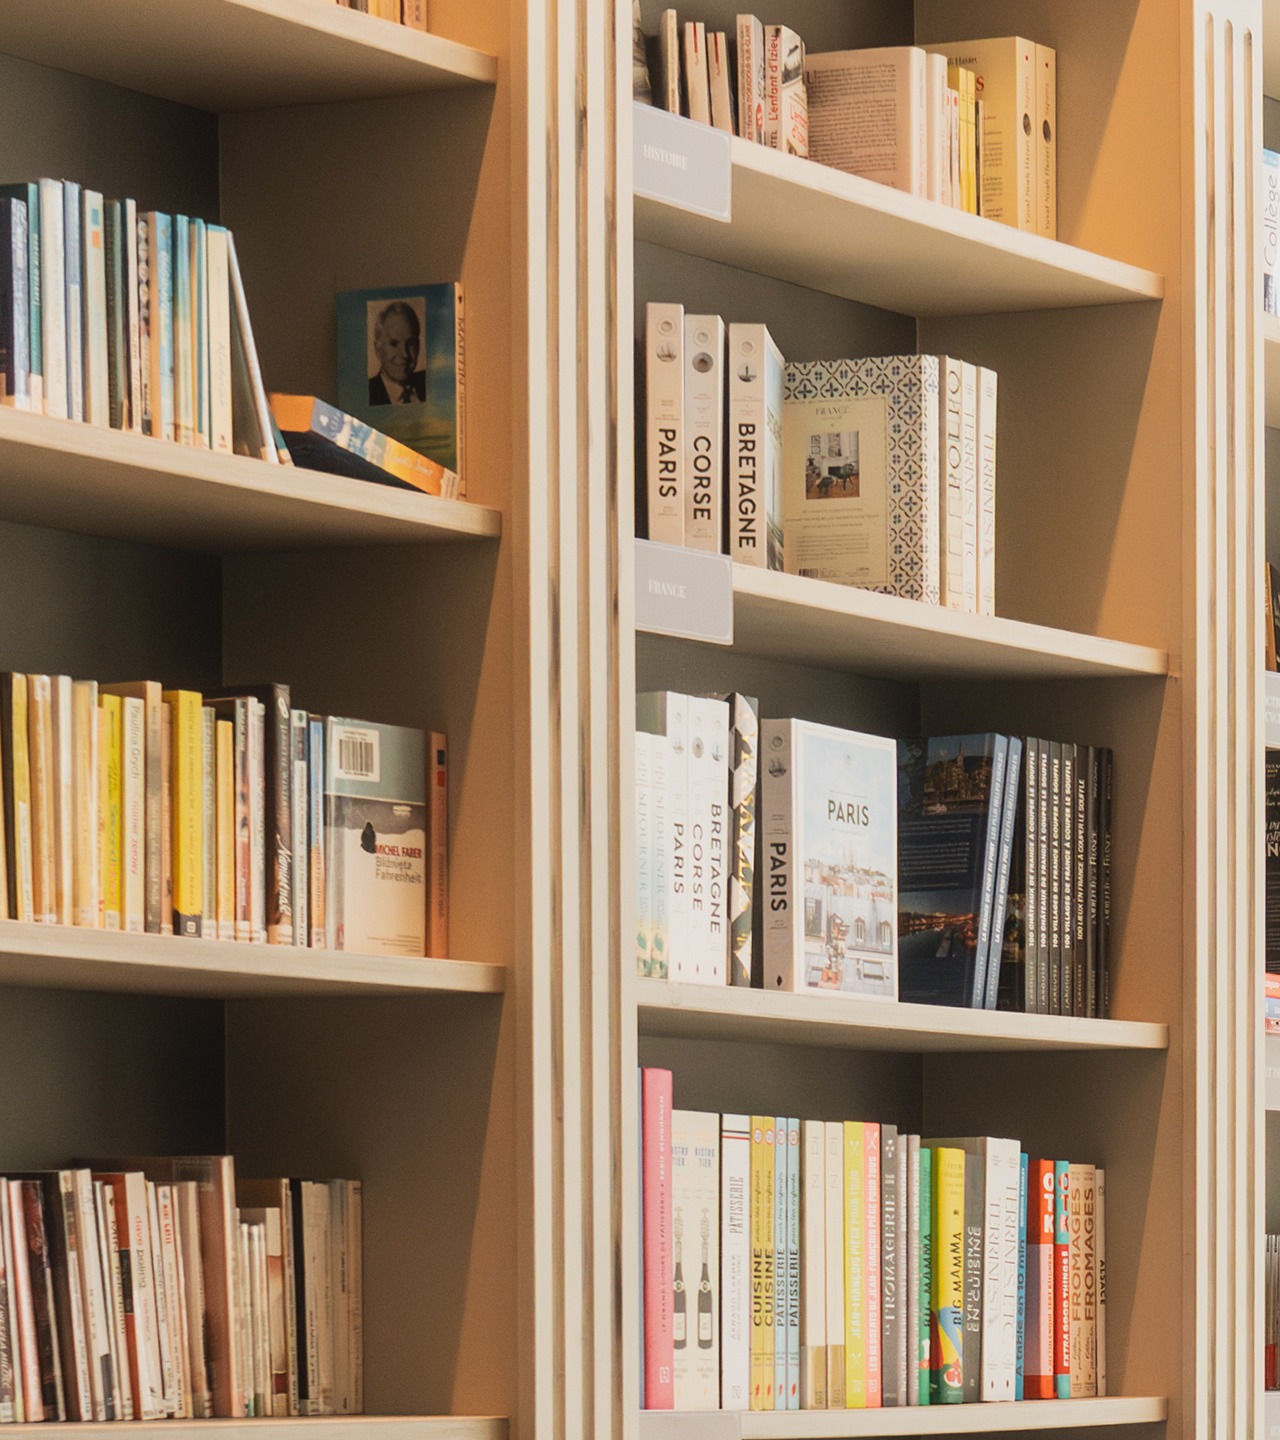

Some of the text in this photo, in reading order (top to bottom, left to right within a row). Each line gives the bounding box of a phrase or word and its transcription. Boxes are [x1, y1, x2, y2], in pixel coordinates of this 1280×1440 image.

[769, 34, 778, 121] L'enfant d'Izieu
[643, 143, 689, 170] HISTOIRE
[1264, 174, 1280, 267] Collège
[658, 427, 677, 498] PARIS
[693, 436, 711, 520] CORSE
[738, 423, 756, 549] BRETAGNE
[648, 579, 686, 598] FRANCE
[129, 747, 140, 780] Grych
[130, 705, 140, 745] Paulina
[375, 844, 423, 859] MICHEL FABER
[827, 799, 870, 827] PARIS
[673, 823, 684, 895] PARIS
[692, 824, 703, 911] CORSE
[710, 803, 722, 934] BRETAGNE
[770, 841, 787, 912] PARIS
[698, 1157, 712, 1167] TIER
[135, 1215, 144, 1246] dave
[851, 1226, 861, 1254] PIÈGE
[868, 1157, 878, 1371] LES DESSERTS JEAN-FRANÇOIS PIÈGE POUR TOUS
[885, 1195, 895, 1320] FROMAGERIE
[973, 1227, 981, 1301] CUISINE
[1071, 1188, 1081, 1322] FROMAGES
[1084, 1188, 1094, 1321] FROMAGES
[754, 1247, 763, 1327] CUISINE
[765, 1247, 773, 1327] CUISINE
[776, 1247, 785, 1327] PÂTISSERIE
[789, 1247, 798, 1327] PÂTISSERIE
[950, 1232, 962, 1325] BIG MAMMA
[1016, 1318, 1024, 1363] table
